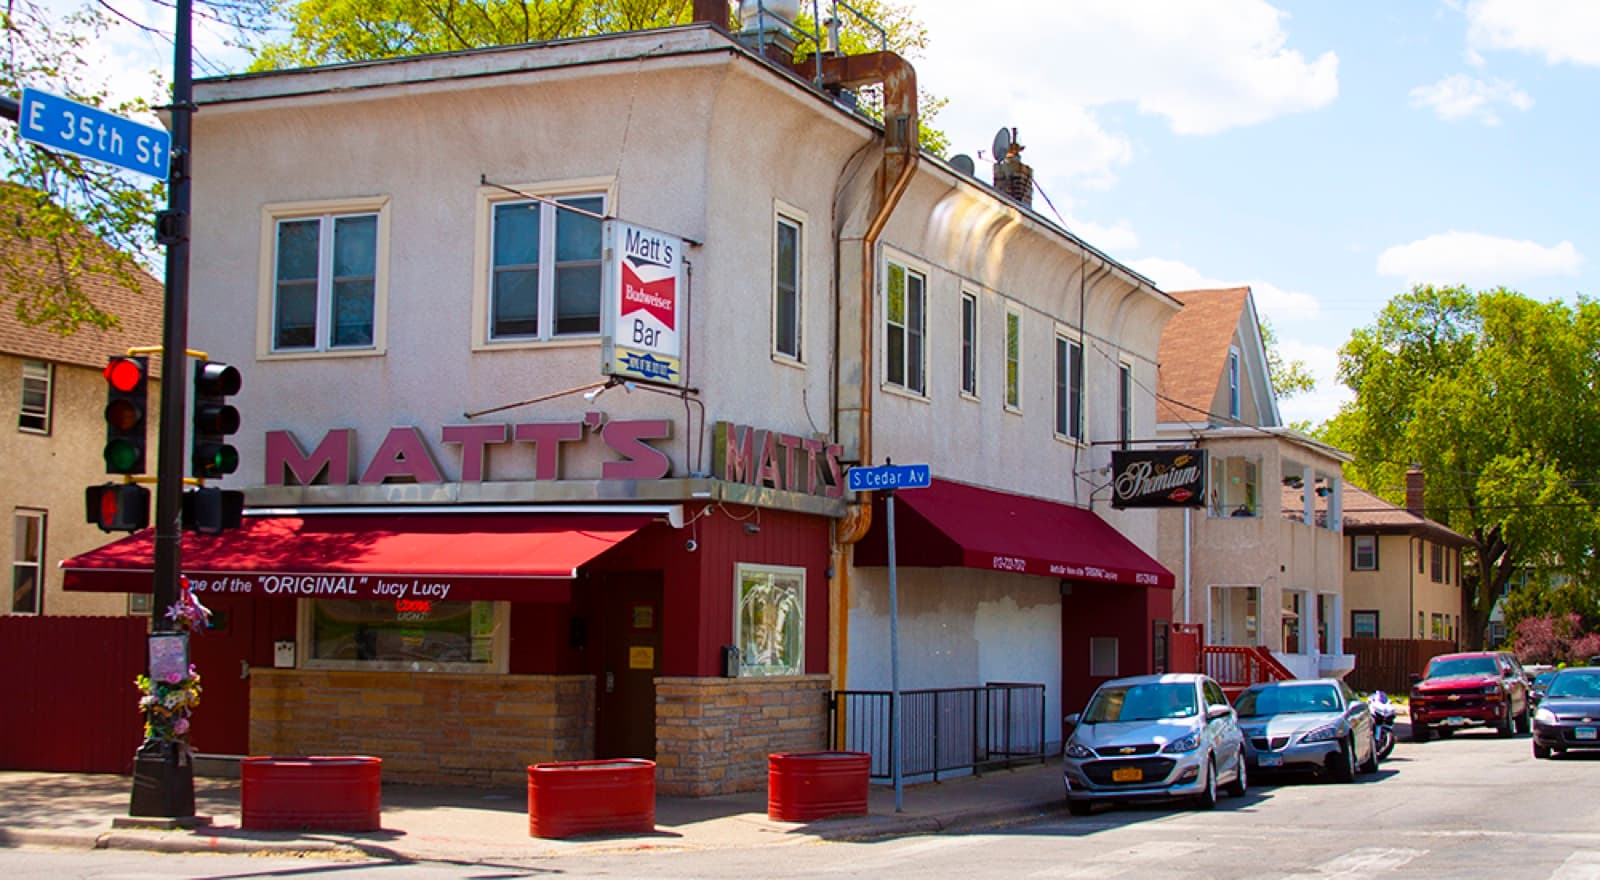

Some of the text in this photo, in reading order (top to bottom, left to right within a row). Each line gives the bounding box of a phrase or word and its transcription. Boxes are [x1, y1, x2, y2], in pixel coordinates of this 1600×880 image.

[29, 101, 162, 168] E 35th St
[625, 227, 673, 264] Matt's
[625, 284, 672, 310] Budweiser
[633, 319, 661, 348] Bar
[265, 411, 673, 486] MATT'S
[724, 421, 844, 498] MATT'S
[854, 469, 924, 487] S Cedar Av
[1115, 460, 1200, 500] Premium
[190, 575, 450, 599] me of the "ORIGINAL" Jucy Lucy
